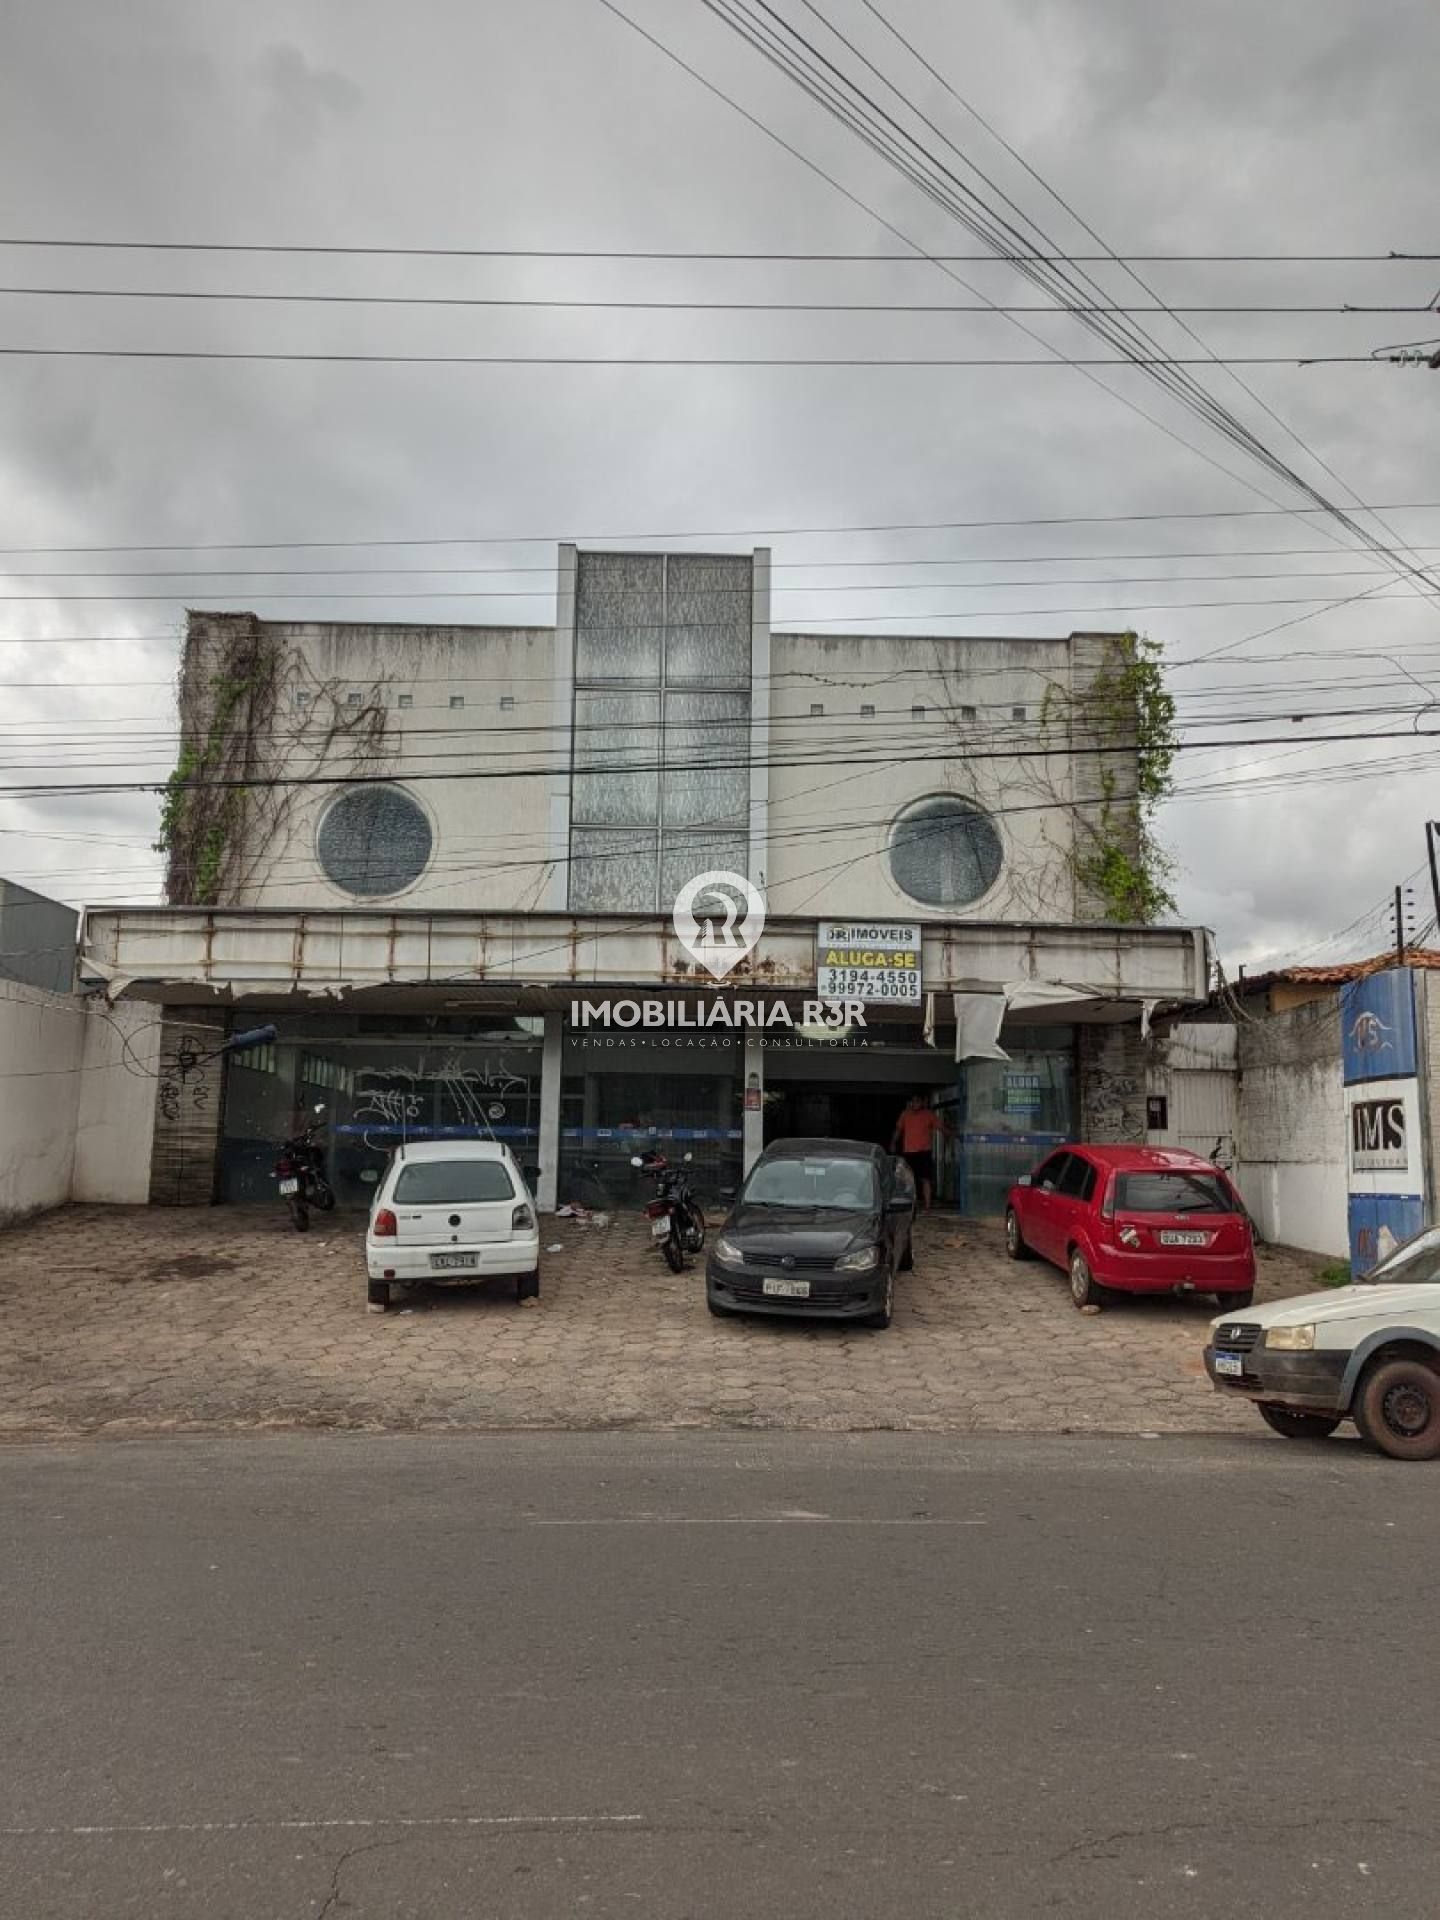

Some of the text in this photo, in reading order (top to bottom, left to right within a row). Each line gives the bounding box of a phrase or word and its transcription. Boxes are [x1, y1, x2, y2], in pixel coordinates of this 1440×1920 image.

[826, 950, 915, 968] ALUGA-SE
[829, 969, 918, 984] 3194-4550
[828, 983, 918, 997] 99972-0005
[1354, 1106, 1406, 1151] IMS
